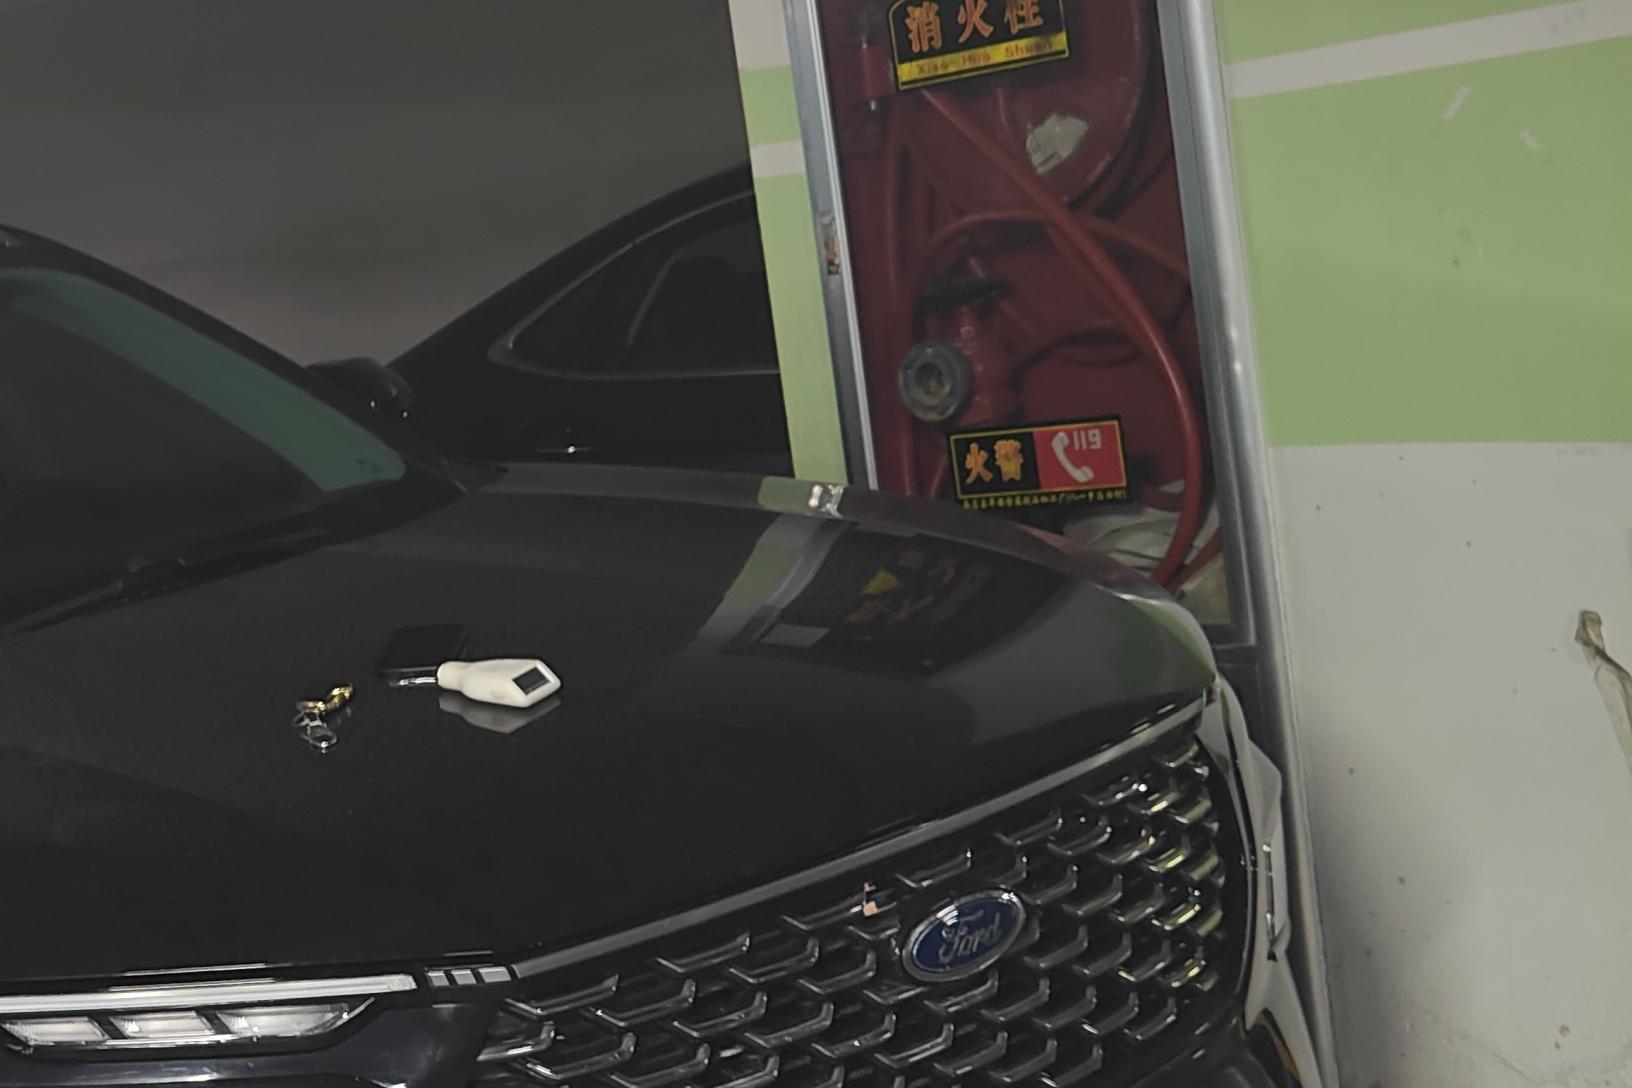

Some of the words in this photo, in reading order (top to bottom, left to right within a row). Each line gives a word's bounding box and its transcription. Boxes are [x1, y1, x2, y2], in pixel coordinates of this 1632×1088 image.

[964, 439, 1024, 485] 火警
[1073, 429, 1102, 451] 119
[938, 909, 1002, 964] Ford
